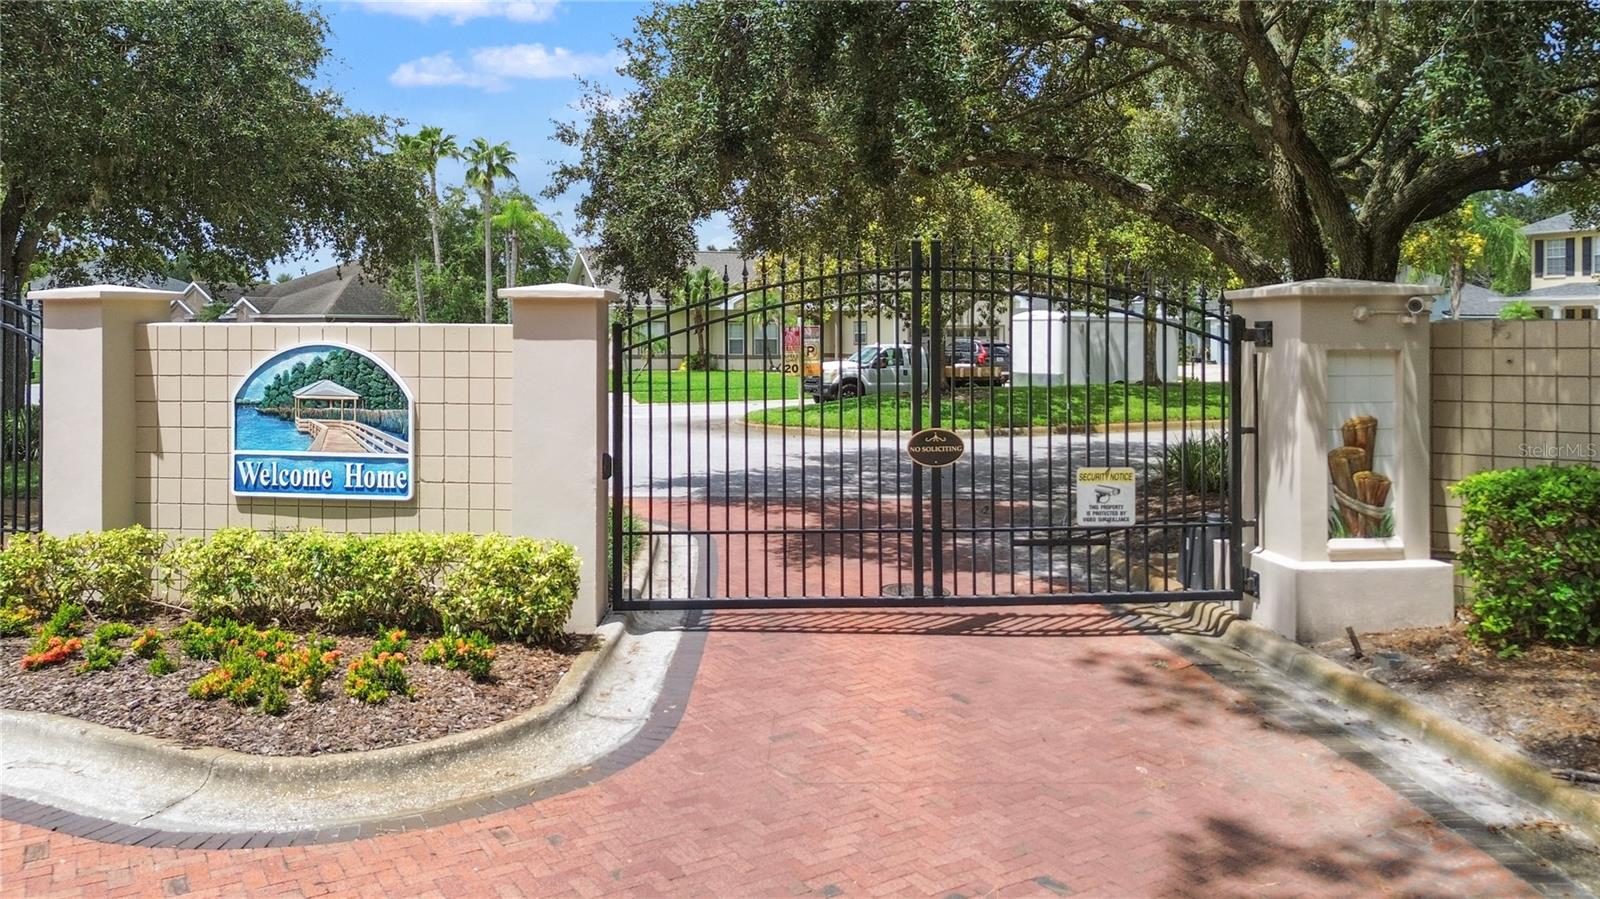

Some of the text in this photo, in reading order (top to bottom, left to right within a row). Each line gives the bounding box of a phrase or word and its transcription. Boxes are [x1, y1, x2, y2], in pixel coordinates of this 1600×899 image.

[784, 364, 799, 373] 20
[921, 445, 963, 453] SOLICITING
[237, 461, 408, 489] Welcome Home
[1078, 472, 1132, 481] SECURITY NOTICE
